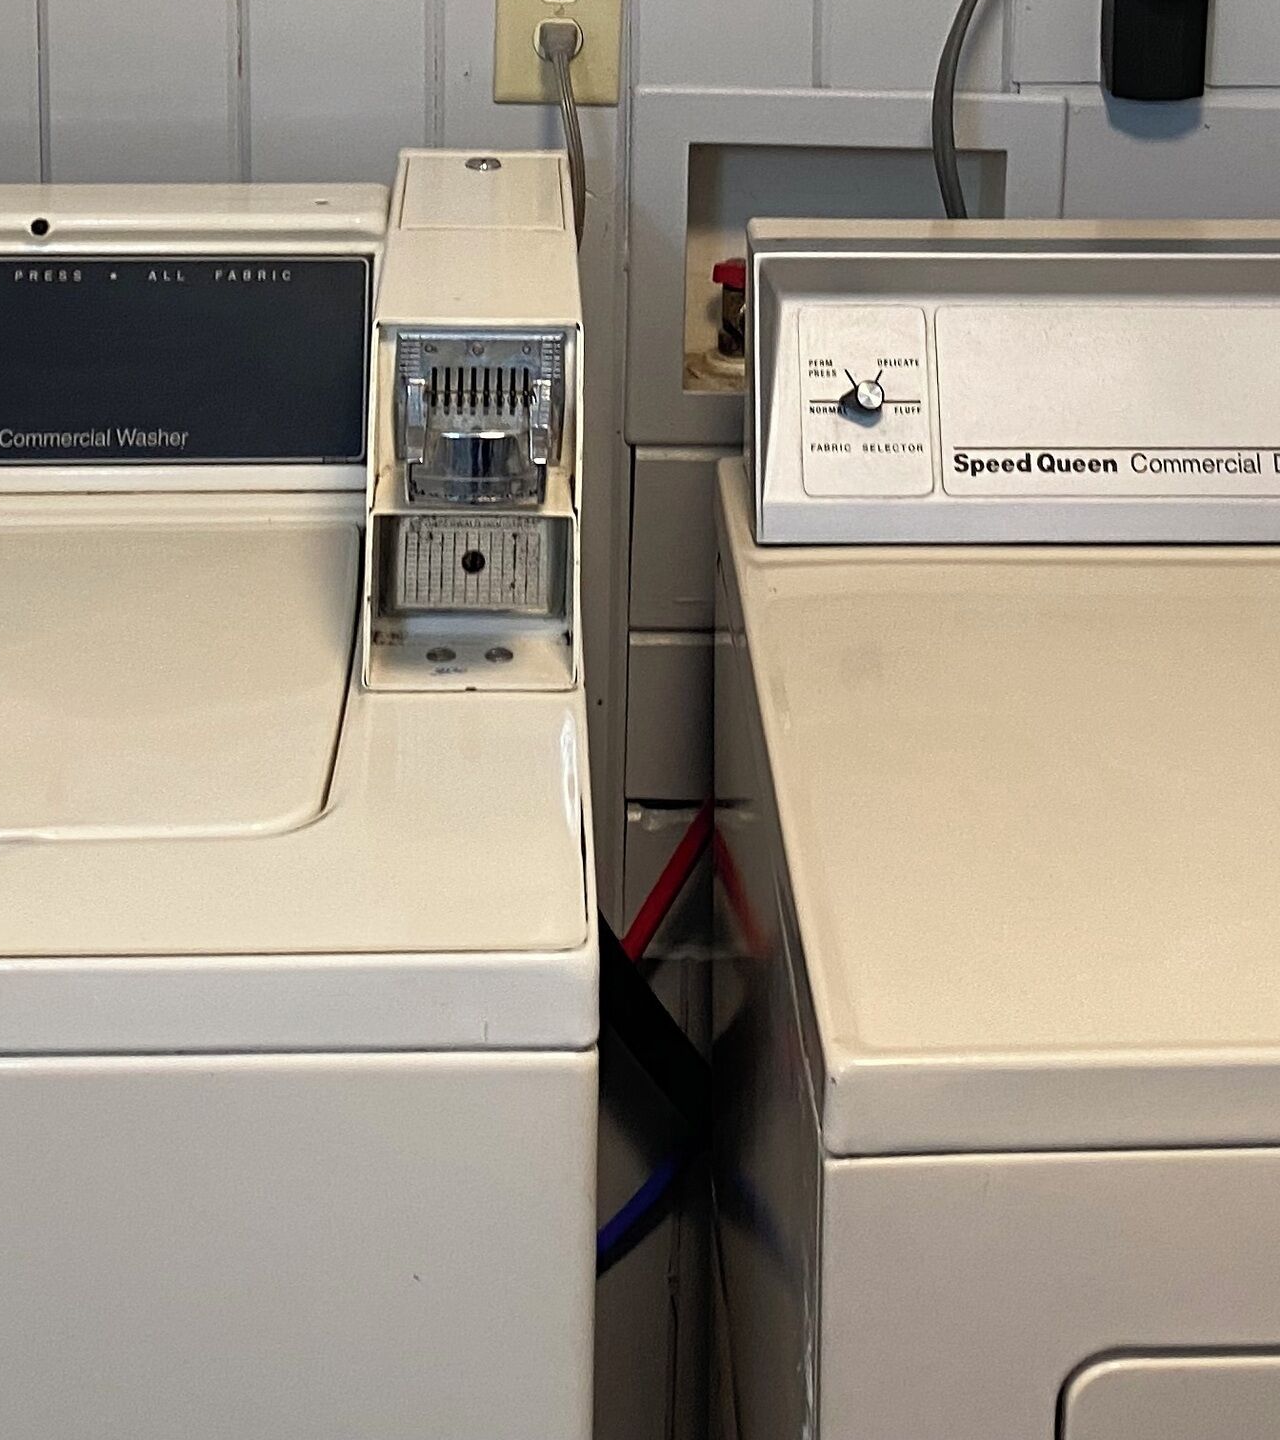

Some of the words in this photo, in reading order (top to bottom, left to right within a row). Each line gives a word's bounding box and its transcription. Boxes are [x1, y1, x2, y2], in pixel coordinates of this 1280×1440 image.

[14, 270, 84, 283] PRESS
[148, 269, 186, 282] ALL
[215, 269, 295, 282] FABRIC
[809, 359, 833, 367] PERM
[877, 359, 920, 367] DELICATE
[809, 369, 837, 378] PRESS
[895, 407, 921, 415] FLUFF
[116, 428, 189, 450] Washer
[811, 444, 852, 453] FABRIC
[863, 444, 924, 453] SELECTOR
[953, 453, 1032, 478] Speed
[1036, 453, 1118, 475] Queen
[1130, 452, 1262, 474] Commercial
